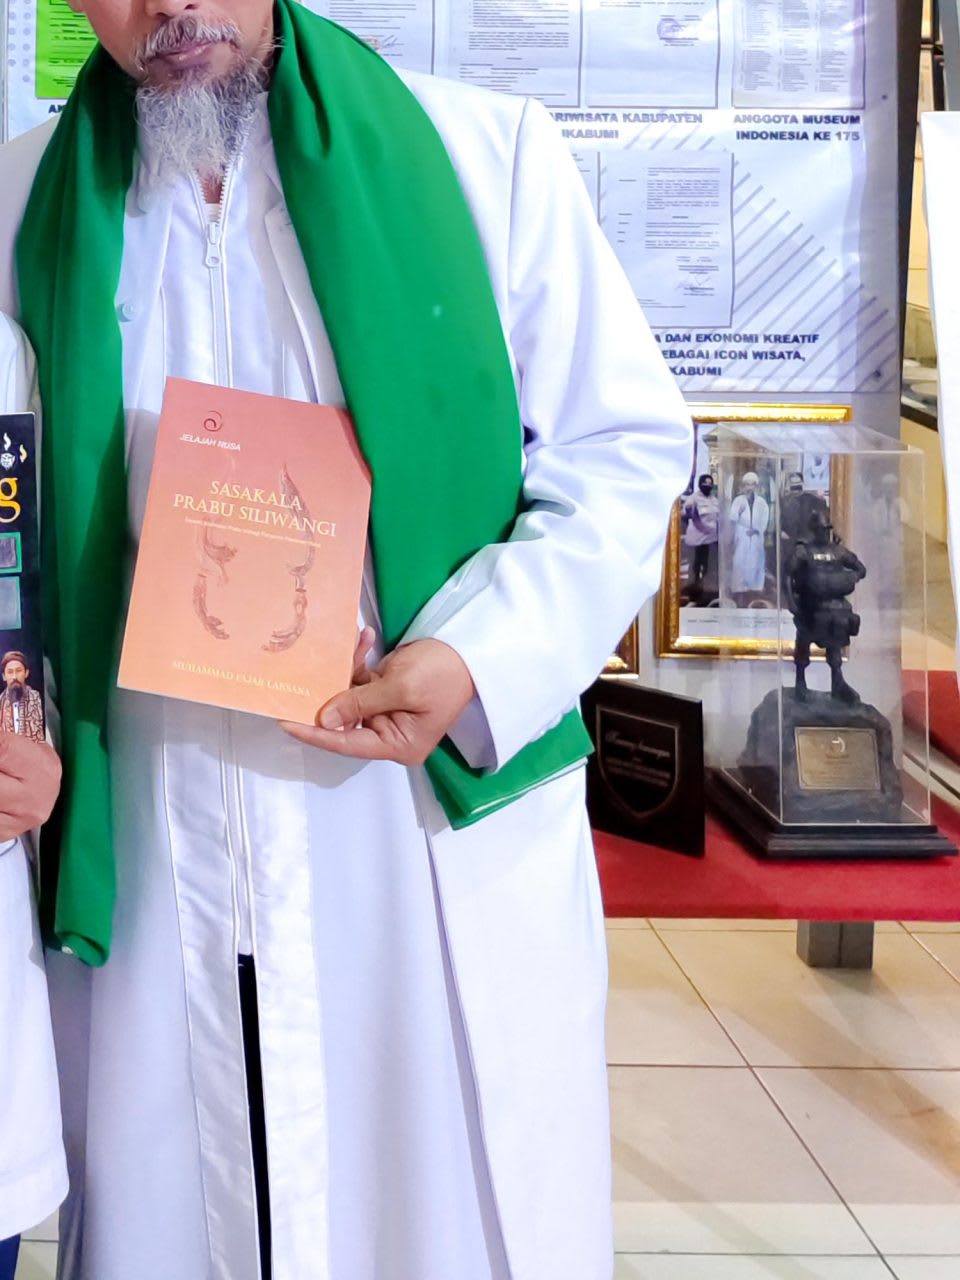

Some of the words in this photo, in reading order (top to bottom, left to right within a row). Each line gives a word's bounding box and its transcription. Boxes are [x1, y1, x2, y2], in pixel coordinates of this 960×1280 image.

[622, 112, 703, 124] KABUPATEN
[734, 114, 799, 124] ANGGOTA
[802, 114, 860, 125] MUSEUM
[736, 130, 810, 141] INDONESIA
[813, 131, 831, 141] KE
[836, 131, 860, 141] 175
[665, 333, 691, 342] DAN
[696, 333, 759, 343] EKONOMI
[763, 334, 819, 344] KREATIF
[714, 350, 748, 360] ICON
[752, 350, 806, 362] WISATA,
[210, 480, 303, 511] SASAKALA
[173, 493, 234, 517] PRABU
[239, 505, 337, 537] SILIWANGI
